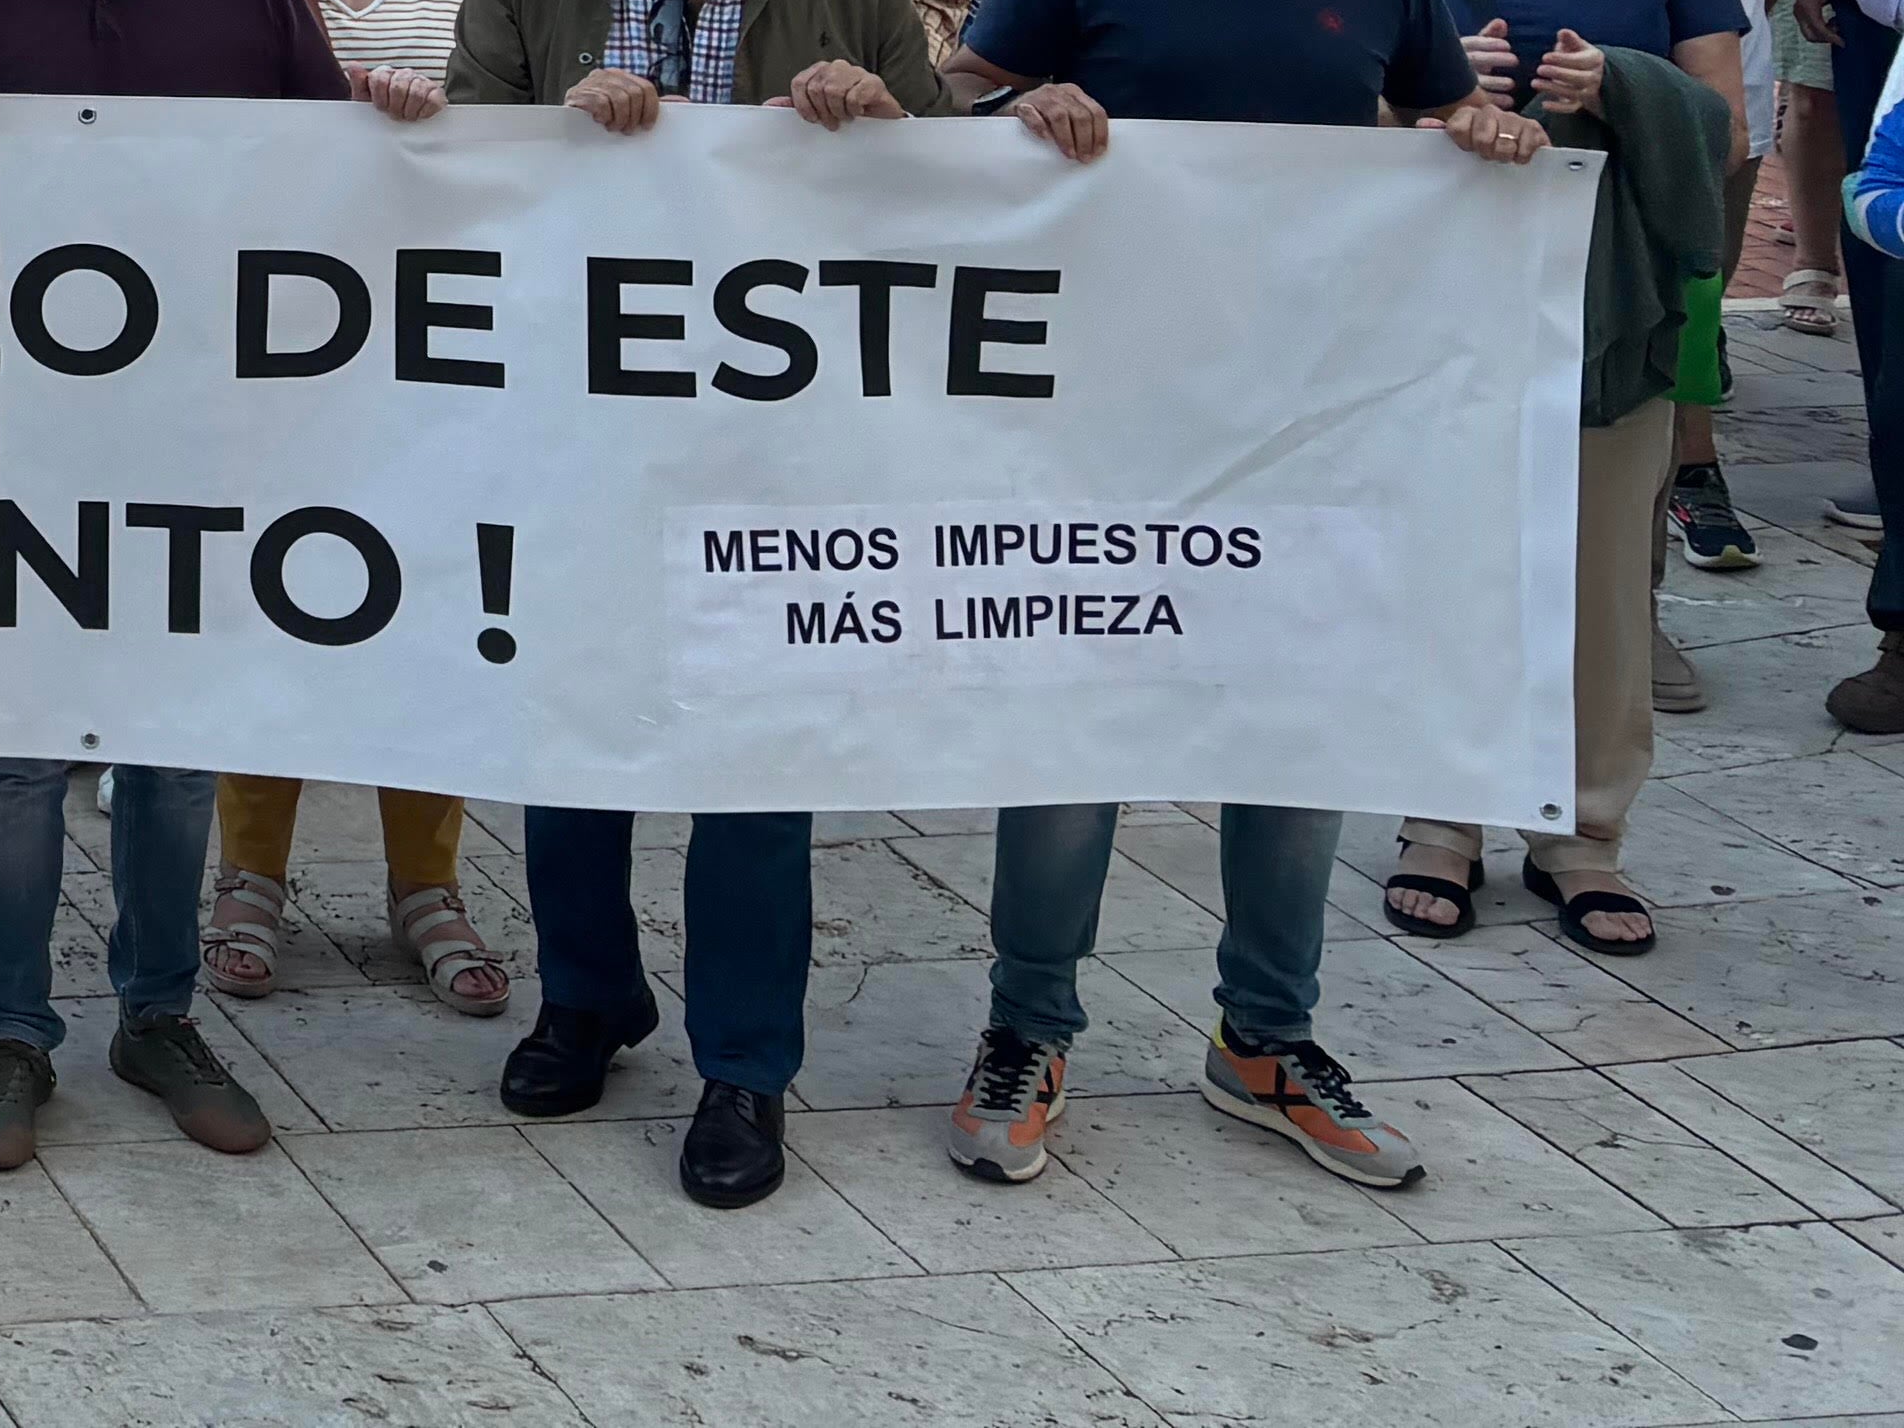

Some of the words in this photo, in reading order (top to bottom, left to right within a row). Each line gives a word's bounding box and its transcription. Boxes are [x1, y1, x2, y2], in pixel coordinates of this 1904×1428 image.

[234, 248, 506, 389] DE
[585, 256, 1063, 402] ESTE
[703, 527, 900, 573] MENOS
[934, 522, 1263, 569] IMPUESTOS
[786, 591, 903, 645] MÁS
[935, 594, 1184, 641] LIMPIEZA
